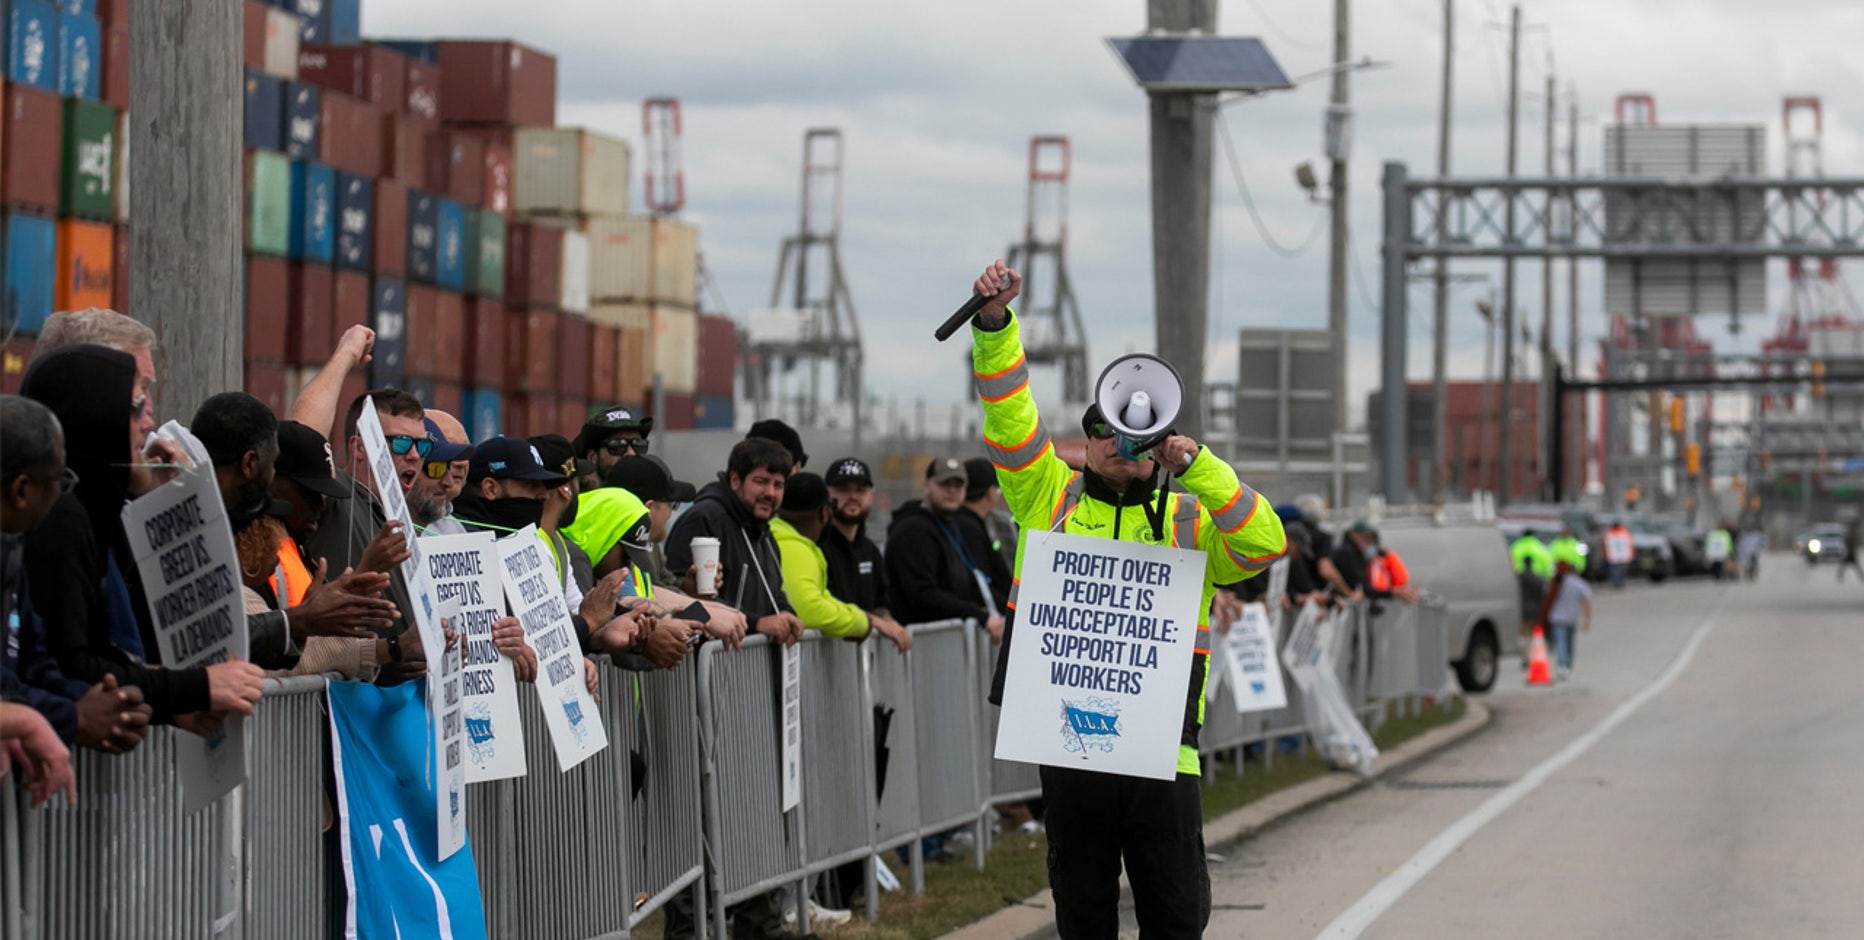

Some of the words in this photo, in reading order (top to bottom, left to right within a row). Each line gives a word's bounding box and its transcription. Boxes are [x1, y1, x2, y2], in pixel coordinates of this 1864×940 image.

[144, 493, 205, 551] CORPORATE
[159, 542, 194, 586] GREED
[428, 550, 483, 579] CORPORATE
[1052, 550, 1120, 580] PROFIT
[1121, 558, 1171, 586] OVER
[153, 582, 199, 631] WORKER
[467, 580, 485, 606] VS.
[1061, 579, 1134, 610] PEOPLE
[1136, 588, 1155, 612] IS
[185, 604, 233, 656] DEMANDS
[1029, 602, 1179, 644] UNACCEPTABLE:
[1041, 632, 1127, 665] SUPPORT
[1129, 643, 1158, 669] ILA
[1050, 661, 1143, 695] WORKERS
[1074, 713, 1114, 732] I.L.A.
